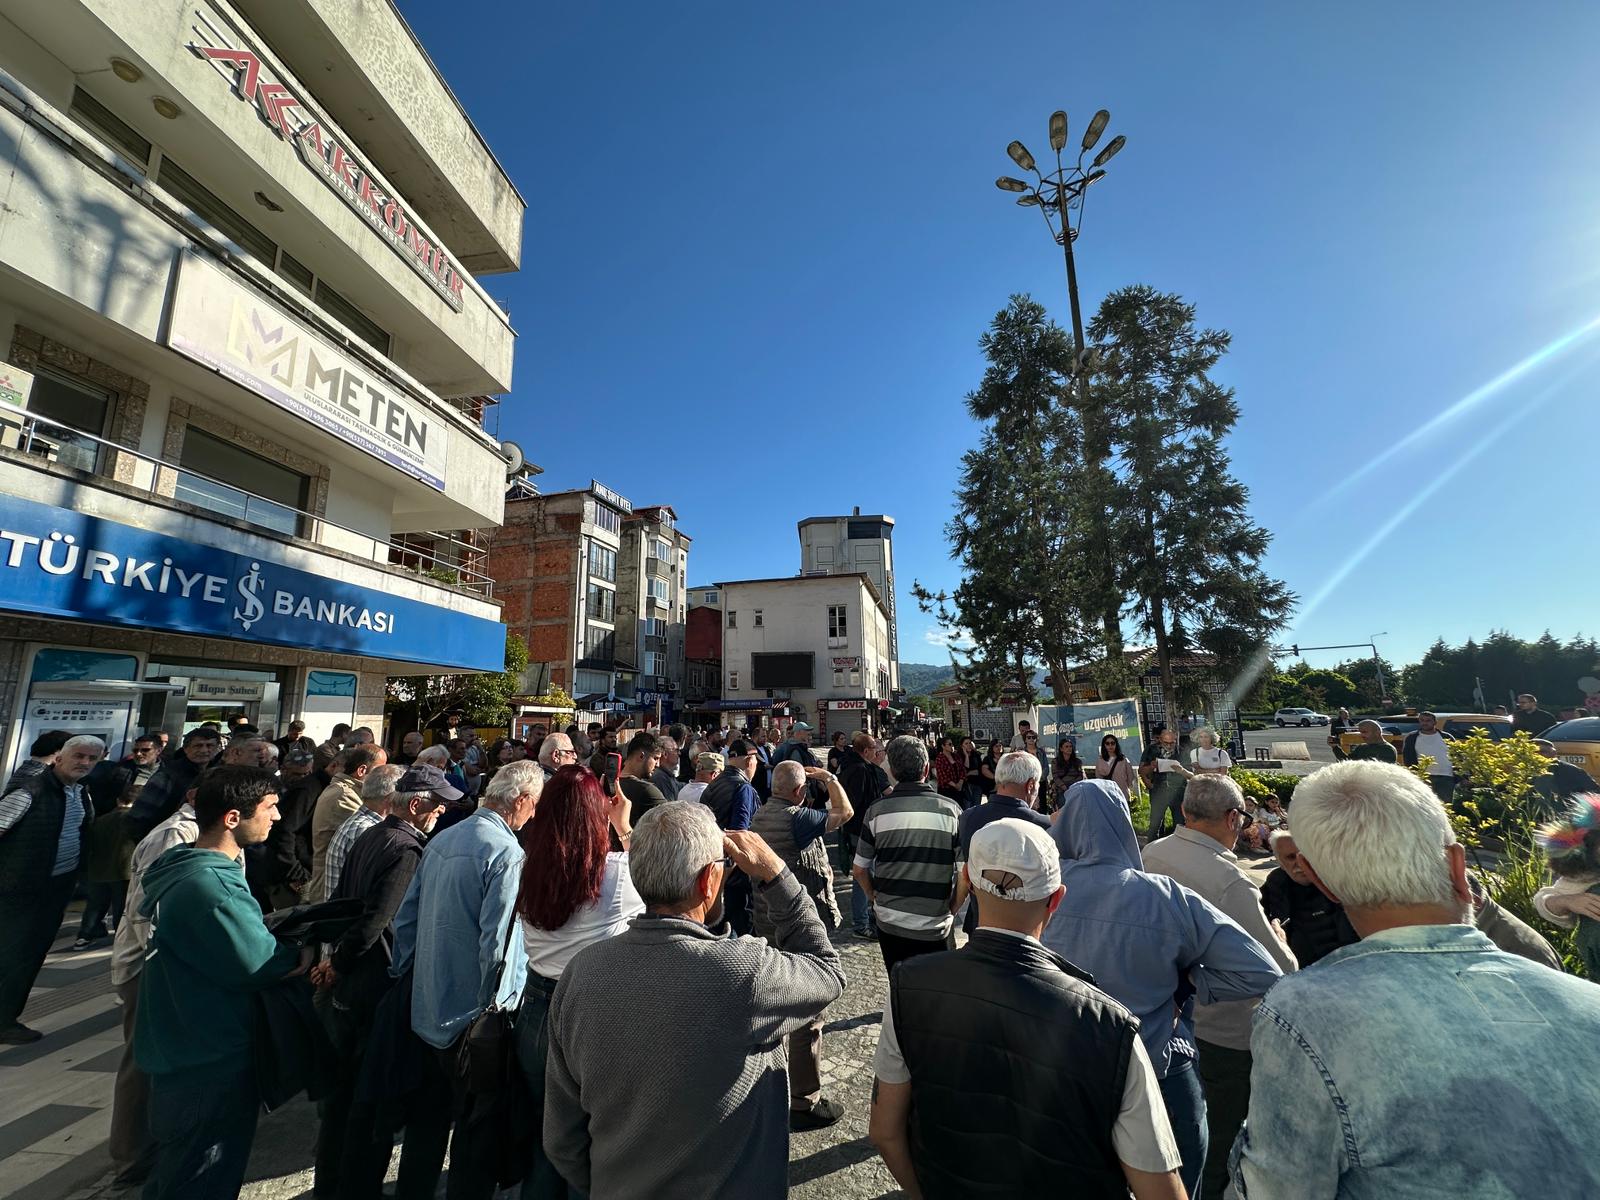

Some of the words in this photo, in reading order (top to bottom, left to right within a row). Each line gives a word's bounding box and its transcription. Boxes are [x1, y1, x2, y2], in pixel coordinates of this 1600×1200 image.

[300, 121, 465, 304] AKKÖMÜR
[303, 391, 351, 425] ULUSLARARASI
[304, 347, 428, 456] METEN
[0, 530, 229, 605] TÜRKİYE
[273, 590, 395, 635] BANKASI
[837, 699, 865, 709] DÖVİZ
